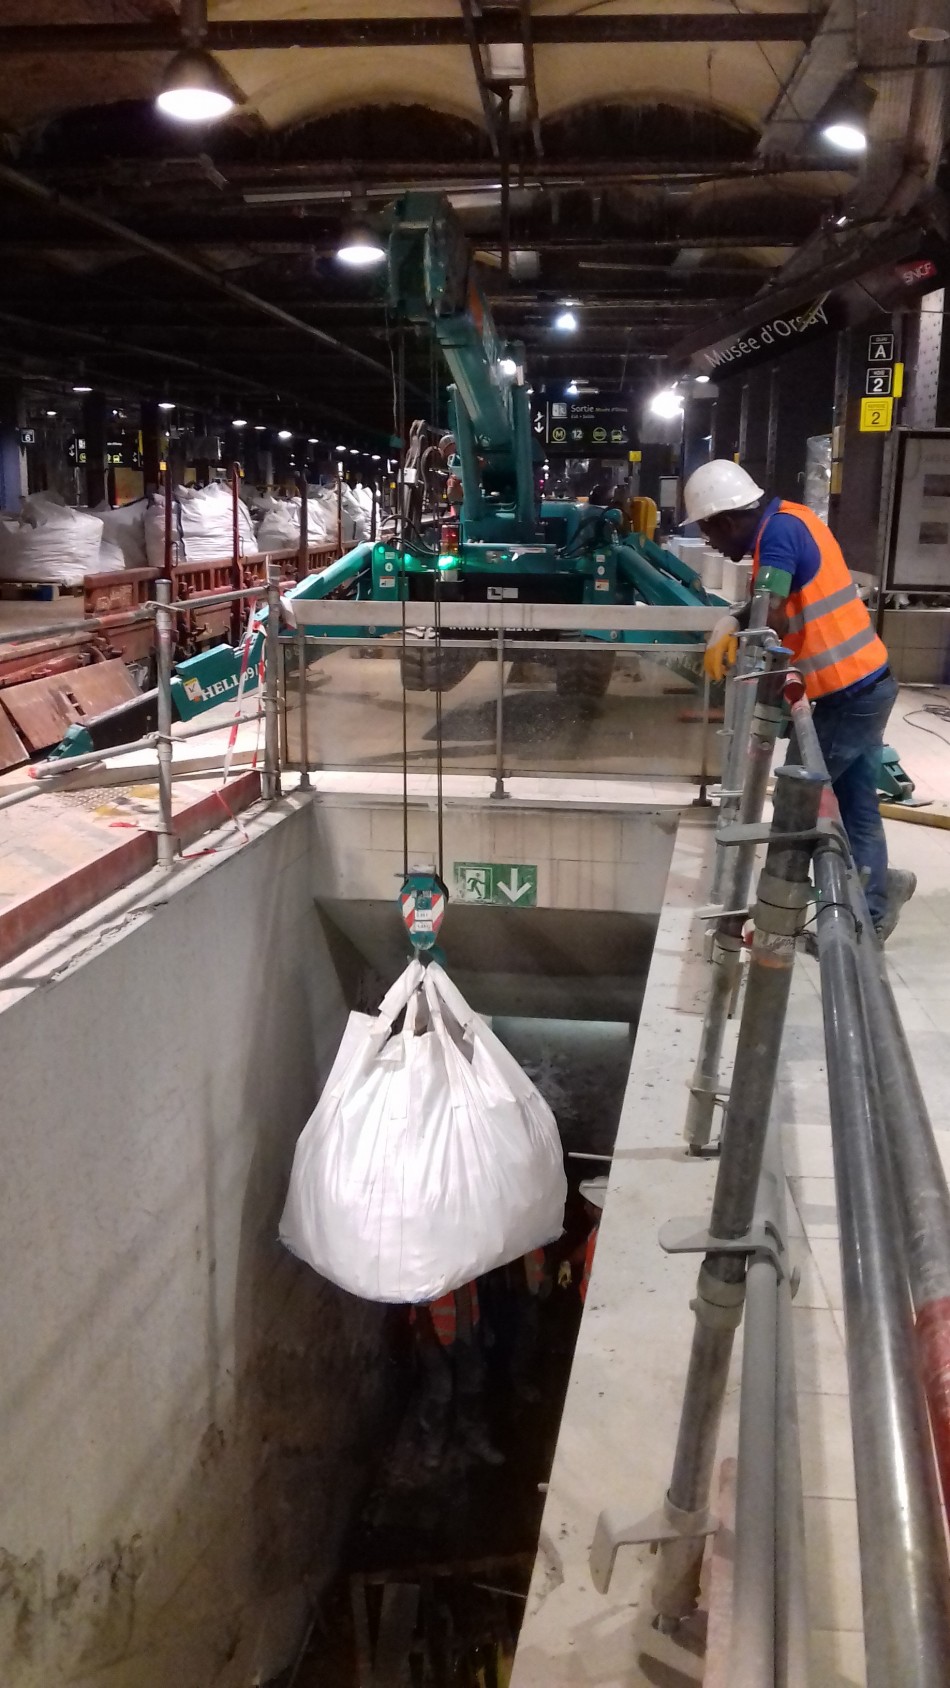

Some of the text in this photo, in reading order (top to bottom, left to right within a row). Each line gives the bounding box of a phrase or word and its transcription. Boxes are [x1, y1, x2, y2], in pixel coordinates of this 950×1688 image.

[902, 261, 932, 285] SNCF
[704, 304, 829, 368] Musée d'Orsay
[874, 344, 887, 359] A
[873, 378, 884, 392] 2
[570, 404, 594, 412] Sortie
[871, 411, 881, 425] 2
[25, 434, 31, 442] 6
[572, 430, 583, 438] 12
